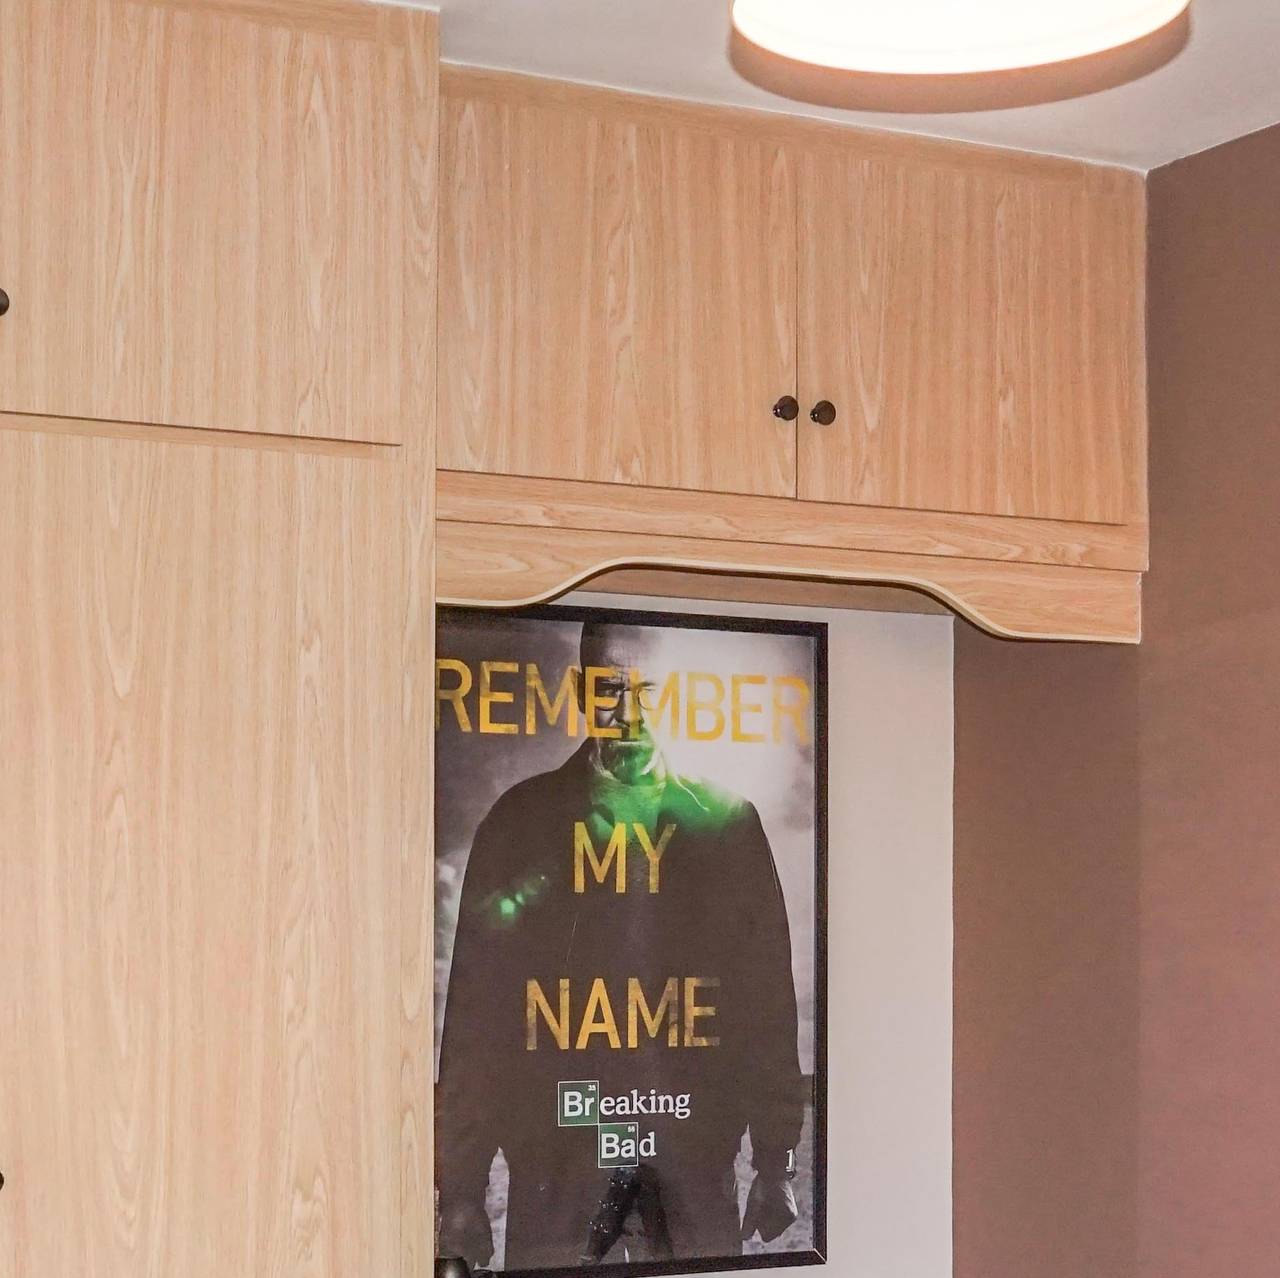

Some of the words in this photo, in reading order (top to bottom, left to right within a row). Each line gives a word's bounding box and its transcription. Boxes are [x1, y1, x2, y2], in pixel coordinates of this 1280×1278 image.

[435, 657, 811, 745] REMEMBER
[574, 821, 677, 893] MY
[526, 977, 721, 1050] NAME
[563, 1089, 691, 1119] Breaking
[601, 1131, 657, 1159] Bad
